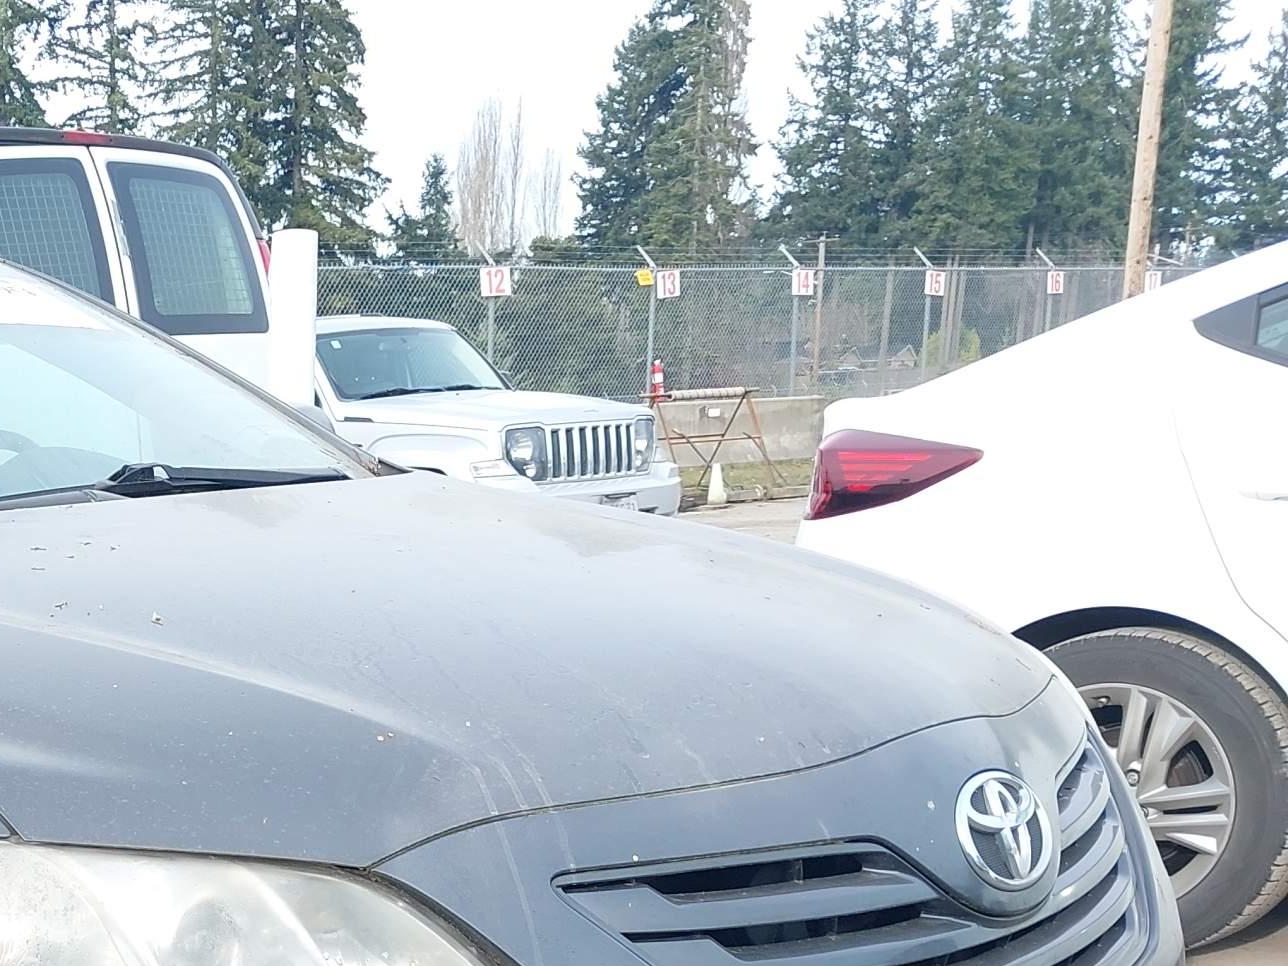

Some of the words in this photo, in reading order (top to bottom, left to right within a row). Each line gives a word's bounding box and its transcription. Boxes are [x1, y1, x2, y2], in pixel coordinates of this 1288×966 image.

[486, 269, 505, 294] 12
[661, 272, 676, 296] 13
[797, 272, 809, 293] 14
[929, 273, 941, 293] 15
[1050, 273, 1061, 292] 16
[1148, 273, 1158, 291] 17
